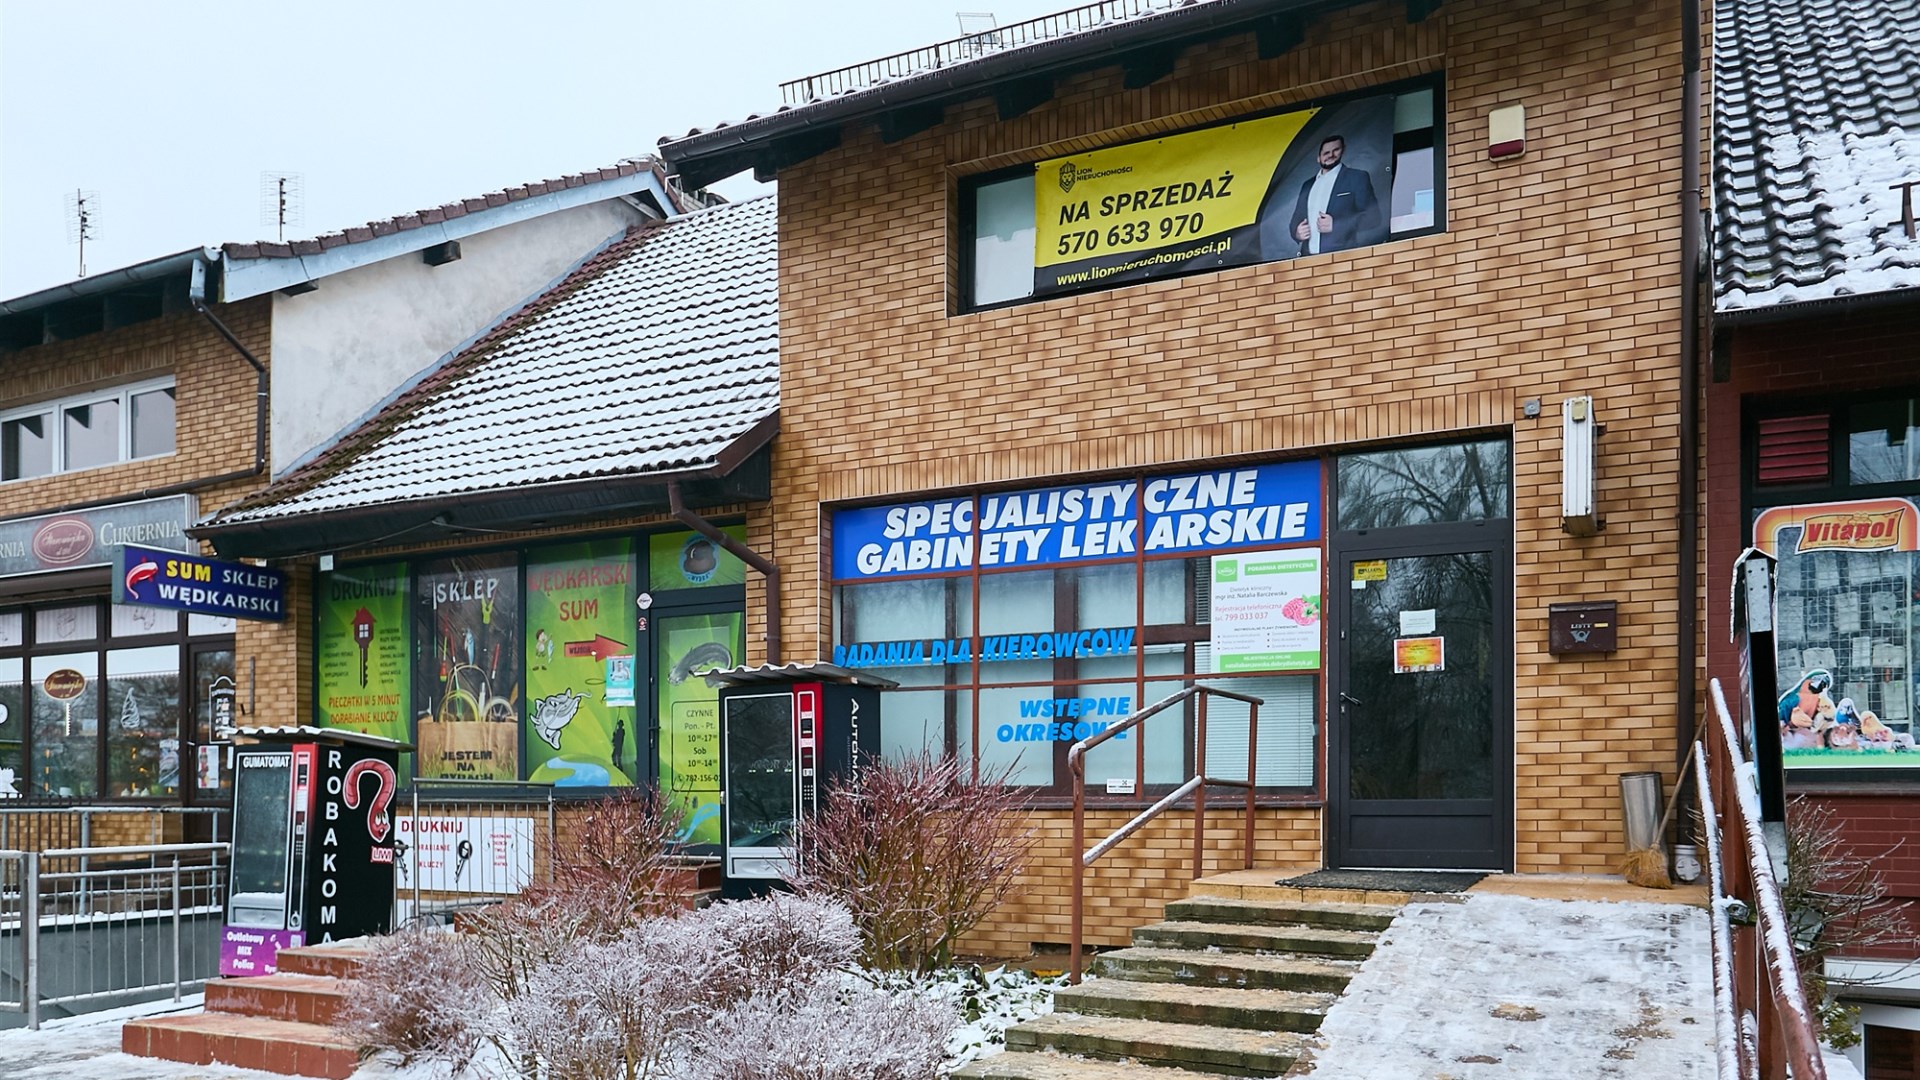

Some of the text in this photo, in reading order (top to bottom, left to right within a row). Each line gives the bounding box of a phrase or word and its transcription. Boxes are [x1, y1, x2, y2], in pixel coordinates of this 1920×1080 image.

[1077, 166, 1133, 182] NIERUCHOMOŚCI
[1059, 170, 1235, 226] NA SPRZEDAŻ
[1057, 212, 1204, 256] 570 633 970
[1057, 237, 1232, 286] www.lionnieruchomosci.pl
[1807, 518, 1895, 543] Vitapol
[856, 527, 1052, 575] GABINETY
[166, 559, 279, 590] SUM SKLEP
[527, 563, 632, 597] WĘDKARSKI
[158, 583, 279, 613] WĘDKARSKI
[332, 577, 397, 602] DRUKNIJ
[436, 578, 498, 604] SKLEP
[560, 598, 599, 621] SUM
[1225, 613, 1238, 621] 799
[1240, 612, 1254, 620] 033
[1255, 612, 1268, 620] 037
[833, 627, 1135, 668] BADANIA DLA KIEROWCÓW
[371, 695, 376, 706] 5
[377, 693, 400, 706] MINUT
[1020, 696, 1131, 719] WSTĘPNE
[330, 710, 398, 724] DORABIANIE KLUCZY
[686, 709, 713, 717] CZYNNE
[243, 756, 290, 768] GUMATOMAT
[440, 750, 492, 761] JESTEM
[456, 762, 475, 772] NA
